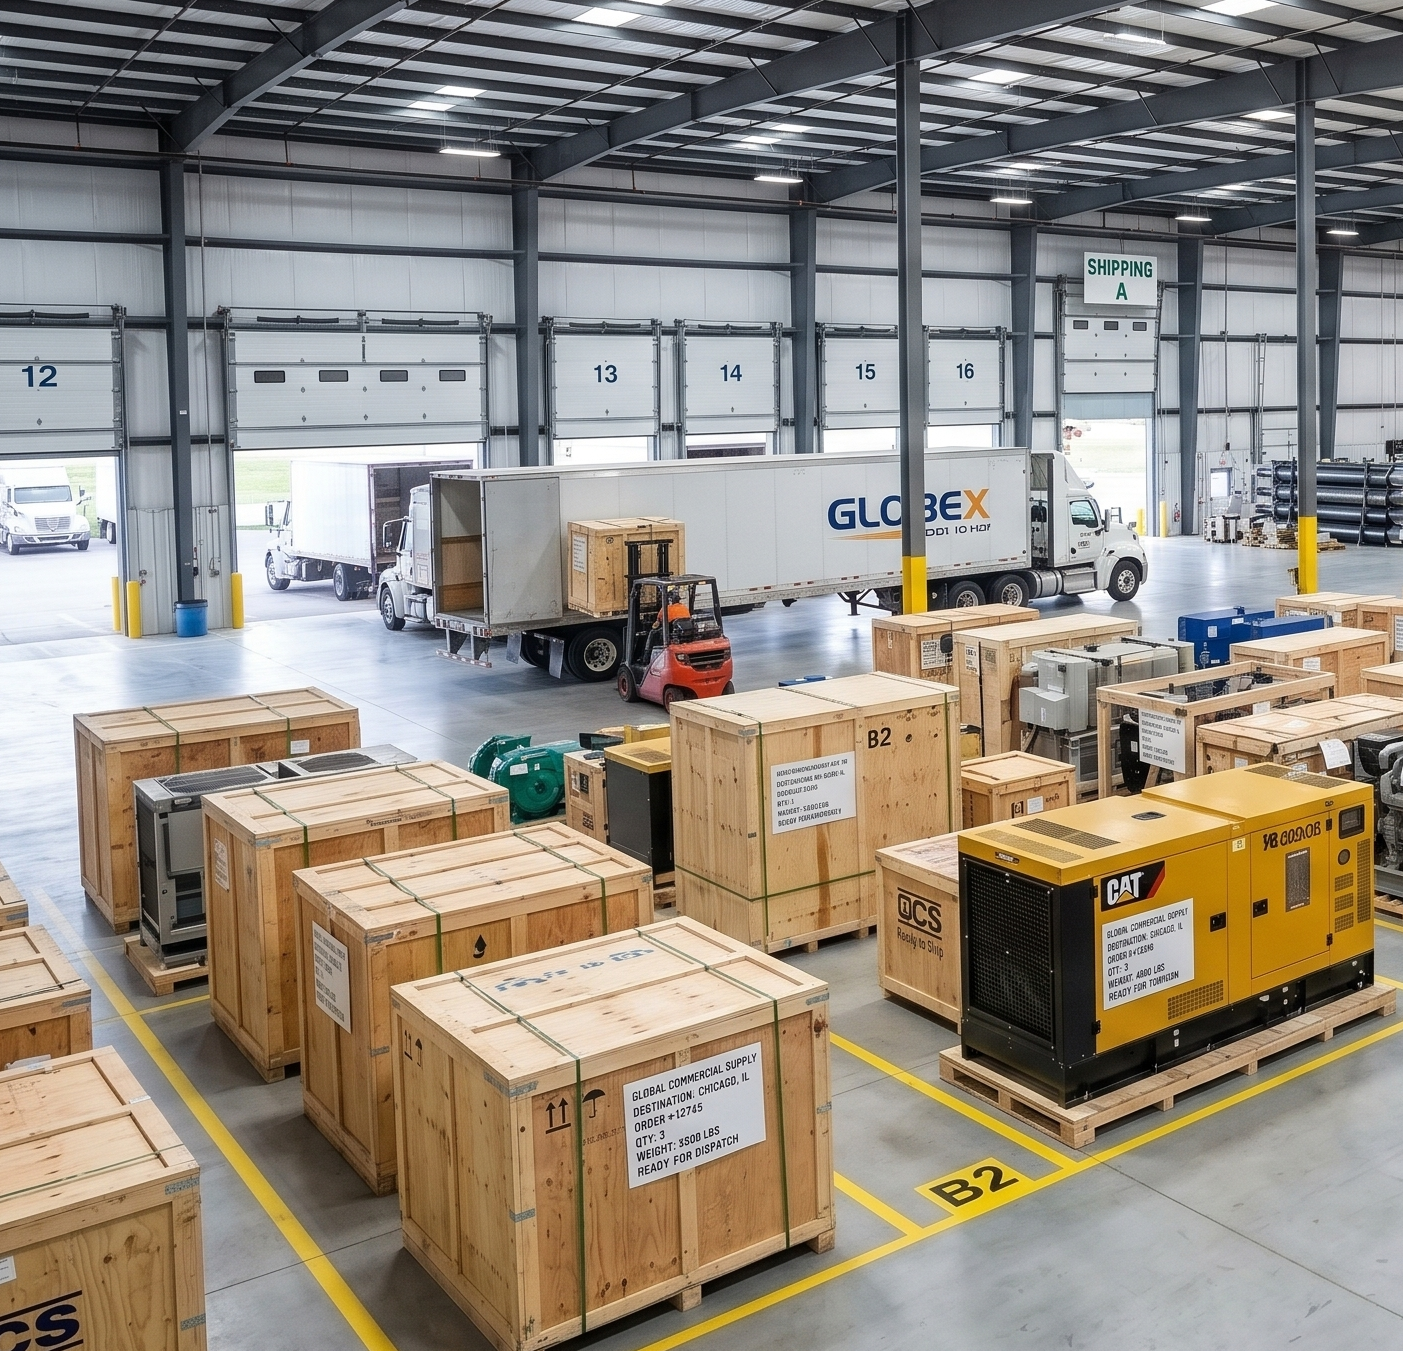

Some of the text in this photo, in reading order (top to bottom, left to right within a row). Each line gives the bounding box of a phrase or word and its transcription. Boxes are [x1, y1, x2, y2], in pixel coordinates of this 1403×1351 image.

[1088, 258, 1153, 278] SHIPPING
[1115, 282, 1128, 300] A
[21, 365, 57, 387] 12
[593, 364, 618, 383] 13
[720, 364, 743, 382] 14
[854, 363, 876, 380] 15
[956, 363, 975, 379] 16
[867, 727, 891, 749] B2
[1107, 871, 1142, 906] CAT
[1124, 962, 1129, 972] 3
[1108, 986, 1132, 1002] READY
[632, 1053, 758, 1102] GLOBAL COMMERCIAL SUPPLY
[633, 1090, 696, 1118] DESTINATION:
[741, 1071, 750, 1083] IL
[634, 1114, 666, 1133] ORDER
[635, 1133, 657, 1149] QTY:
[659, 1130, 666, 1140] 3
[636, 1141, 677, 1162] WEIGHT:
[703, 1125, 721, 1140] LBS
[637, 1133, 740, 1178] READY FOR DISPATCH
[928, 1165, 1020, 1208] B2
